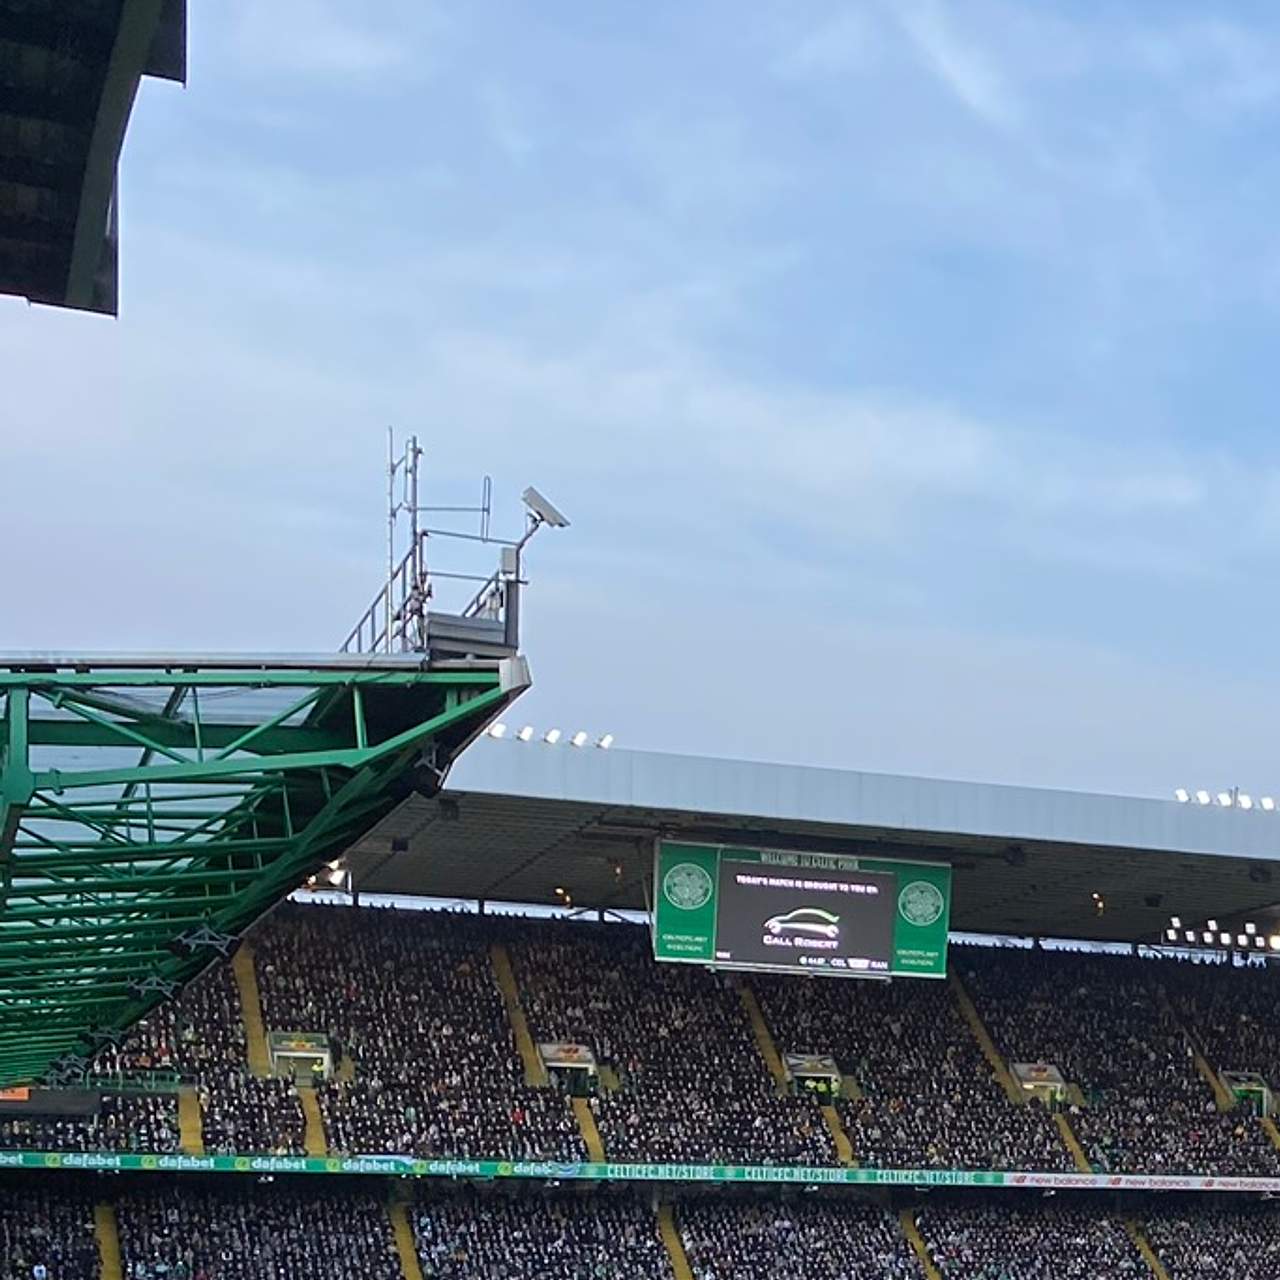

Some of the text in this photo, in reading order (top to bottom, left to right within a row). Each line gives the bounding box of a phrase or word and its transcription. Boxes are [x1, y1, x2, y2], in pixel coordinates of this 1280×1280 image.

[763, 935, 839, 949] CALL ROBERT
[63, 1154, 121, 1167] dafabet
[159, 1155, 215, 1168] dafabet
[252, 1157, 306, 1170] dafabet
[343, 1158, 395, 1172] dafabet
[430, 1160, 480, 1174] dafabet
[1030, 1176, 1051, 1184] new
[1053, 1174, 1098, 1185] balance
[1124, 1178, 1146, 1186] new
[1148, 1176, 1191, 1187] balance
[1217, 1180, 1236, 1188] new
[1238, 1178, 1280, 1189] balance
